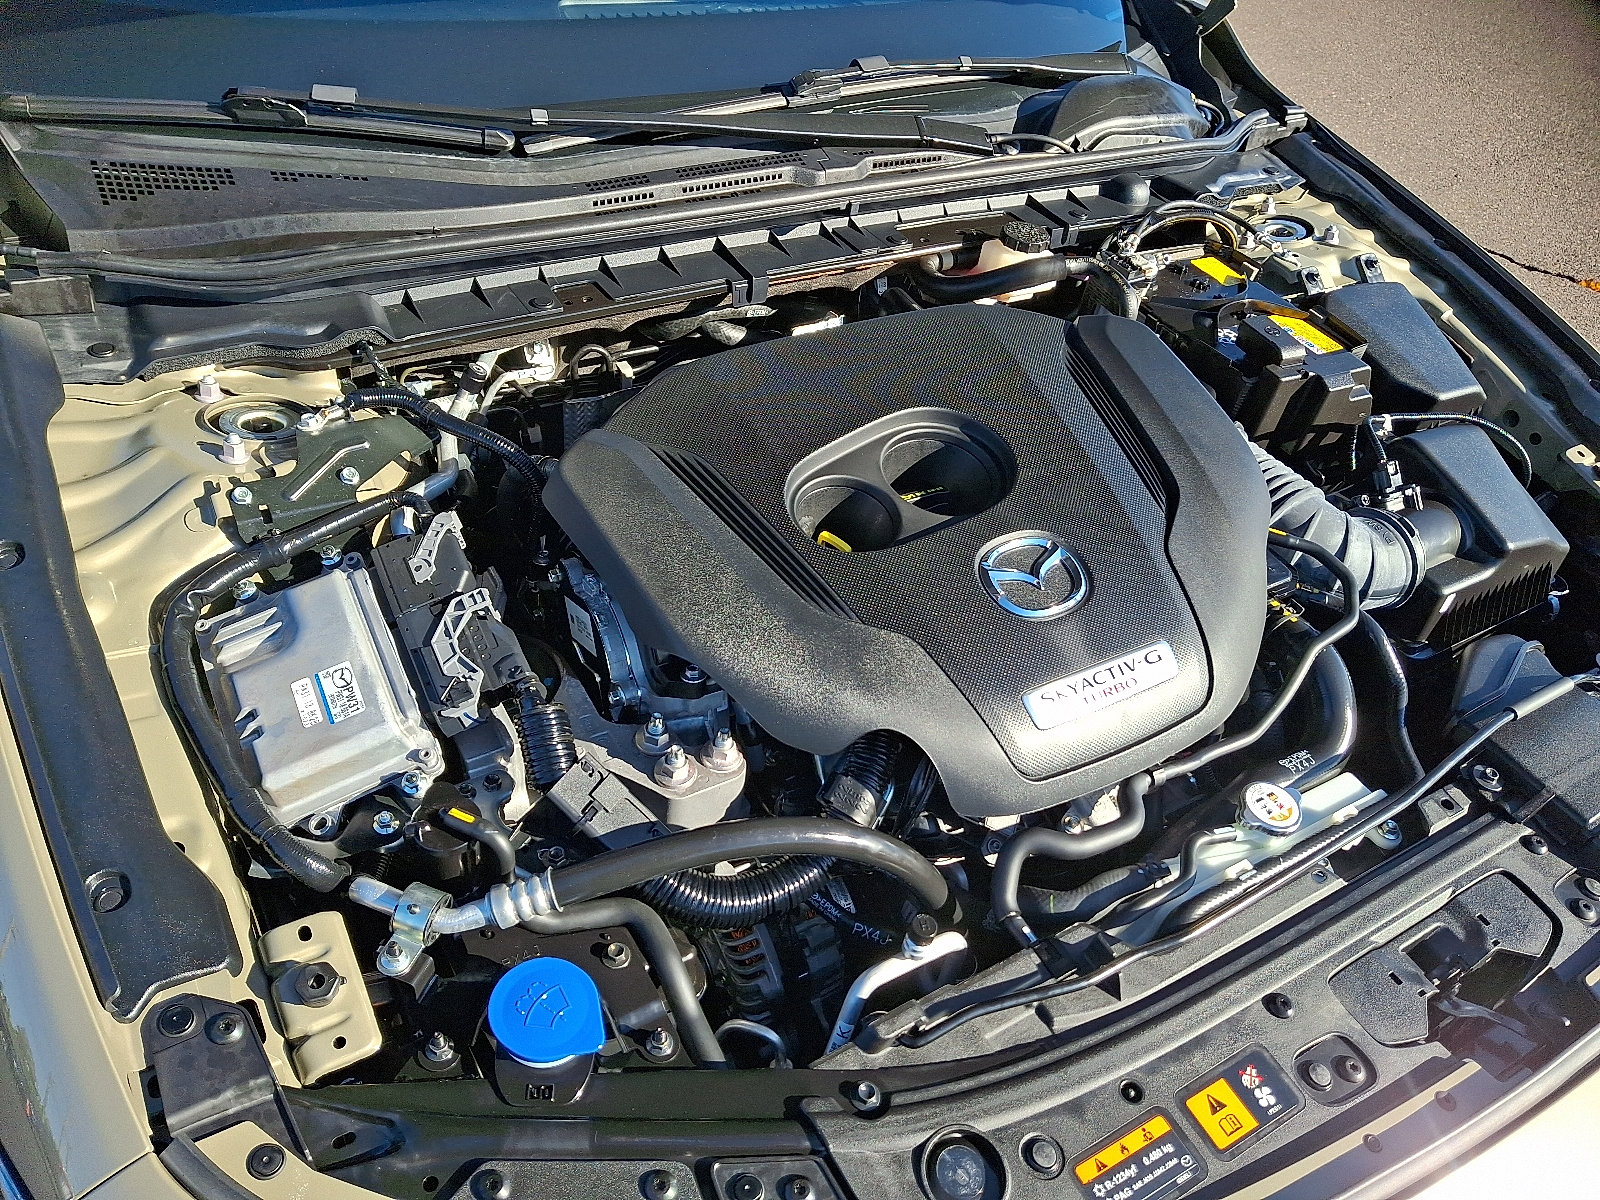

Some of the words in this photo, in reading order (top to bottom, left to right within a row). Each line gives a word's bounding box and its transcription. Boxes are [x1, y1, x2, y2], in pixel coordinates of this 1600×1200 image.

[1041, 650, 1163, 703] SKYACTIV-G
[344, 686, 360, 713] PW31
[1288, 756, 1316, 775] PX4J
[852, 921, 891, 945] PX4J
[836, 1025, 852, 1039] K
